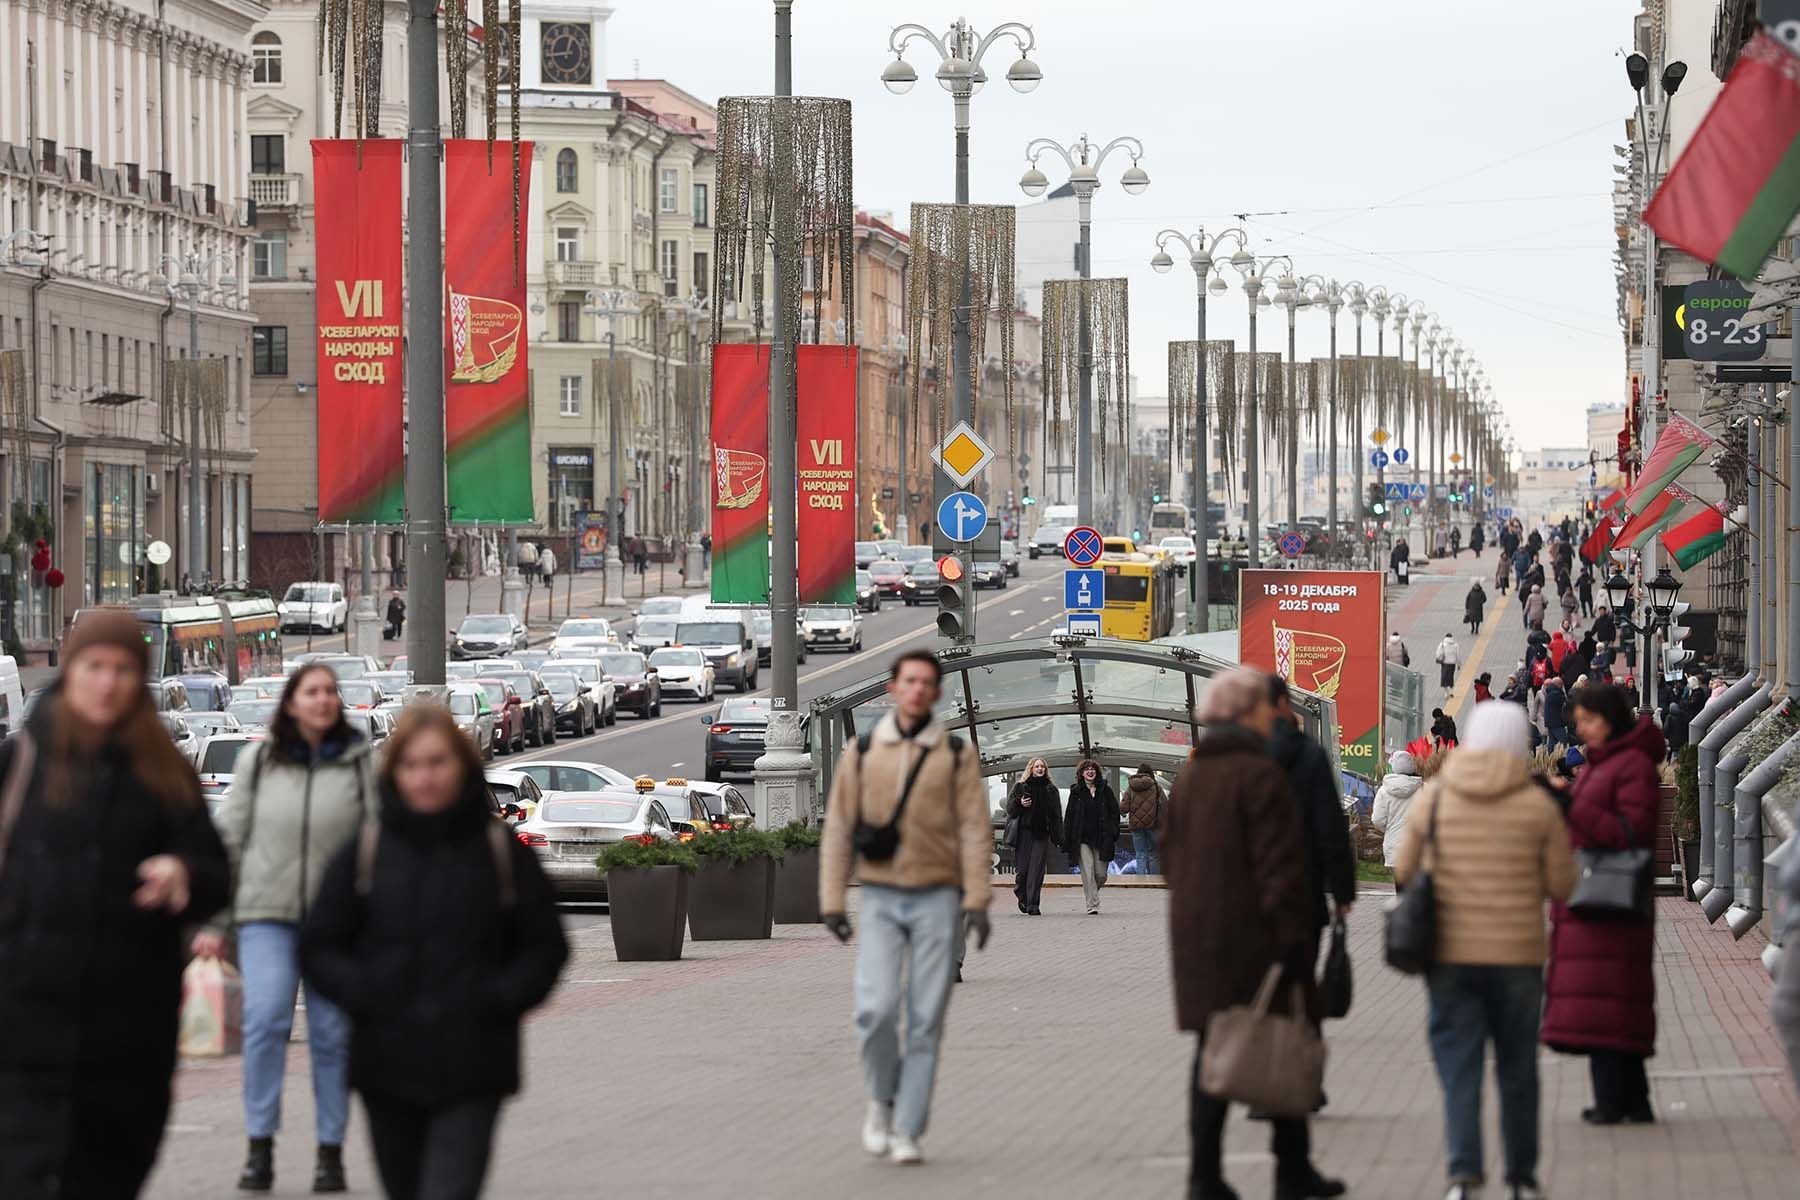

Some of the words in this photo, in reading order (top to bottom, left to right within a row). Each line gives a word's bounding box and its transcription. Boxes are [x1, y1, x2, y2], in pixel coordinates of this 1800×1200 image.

[335, 280, 383, 318] VII
[320, 325, 399, 337] УСЕБЕЛАРУСКІ
[1690, 318, 1761, 344] 8-23
[325, 341, 393, 358] НАРОДНЫ
[335, 362, 385, 384] СХОД
[810, 439, 842, 465] VII
[799, 470, 853, 479] УСЕБЕЛАРУСКІ
[803, 481, 849, 492] НАРОДНЫ
[809, 495, 843, 510] СХОД
[1263, 584, 1298, 595] 18-19
[1300, 585, 1357, 598] ДЕКАБРЯ
[1279, 600, 1309, 611] 2025
[1311, 602, 1340, 613] года
